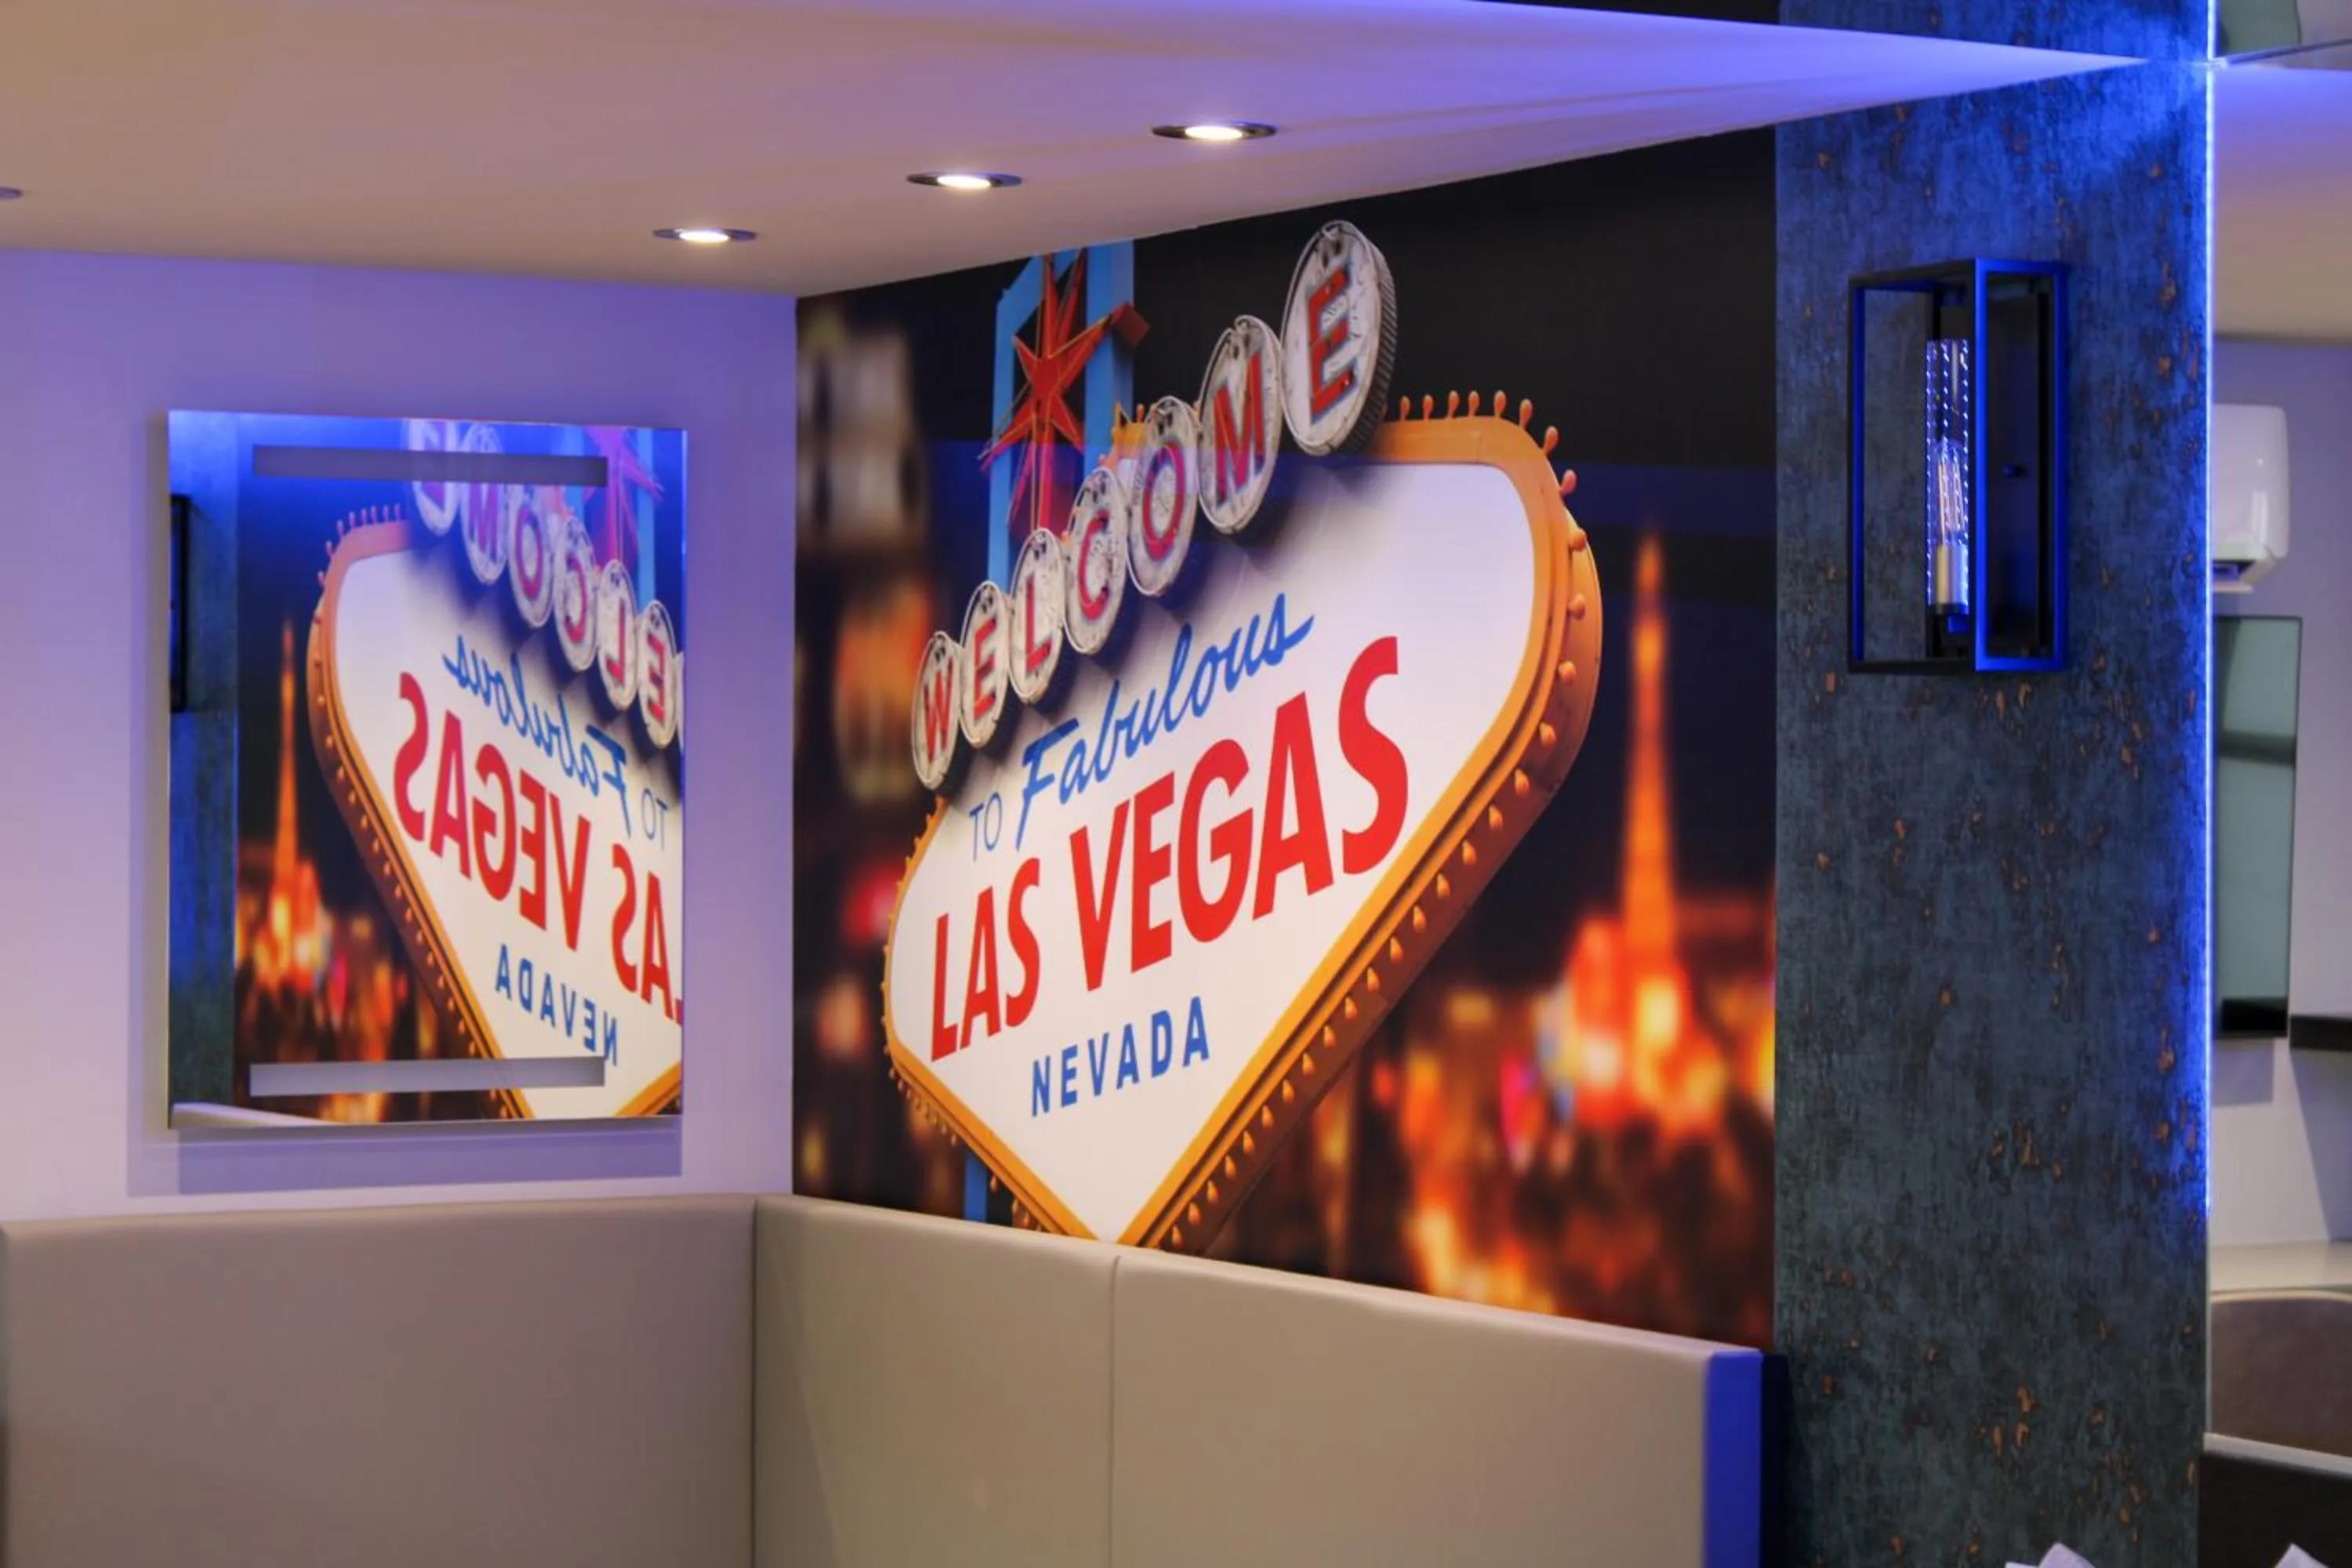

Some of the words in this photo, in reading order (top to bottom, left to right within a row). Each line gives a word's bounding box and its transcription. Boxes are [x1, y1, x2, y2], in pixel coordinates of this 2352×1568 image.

[921, 260, 1358, 764] WELCOME
[931, 857, 1040, 1062] LAS
[1069, 635, 1409, 993] VEGAS
[969, 791, 1003, 862] TO
[1016, 593, 1315, 852] Fabulous
[1031, 996, 1210, 1118] NEVADA
